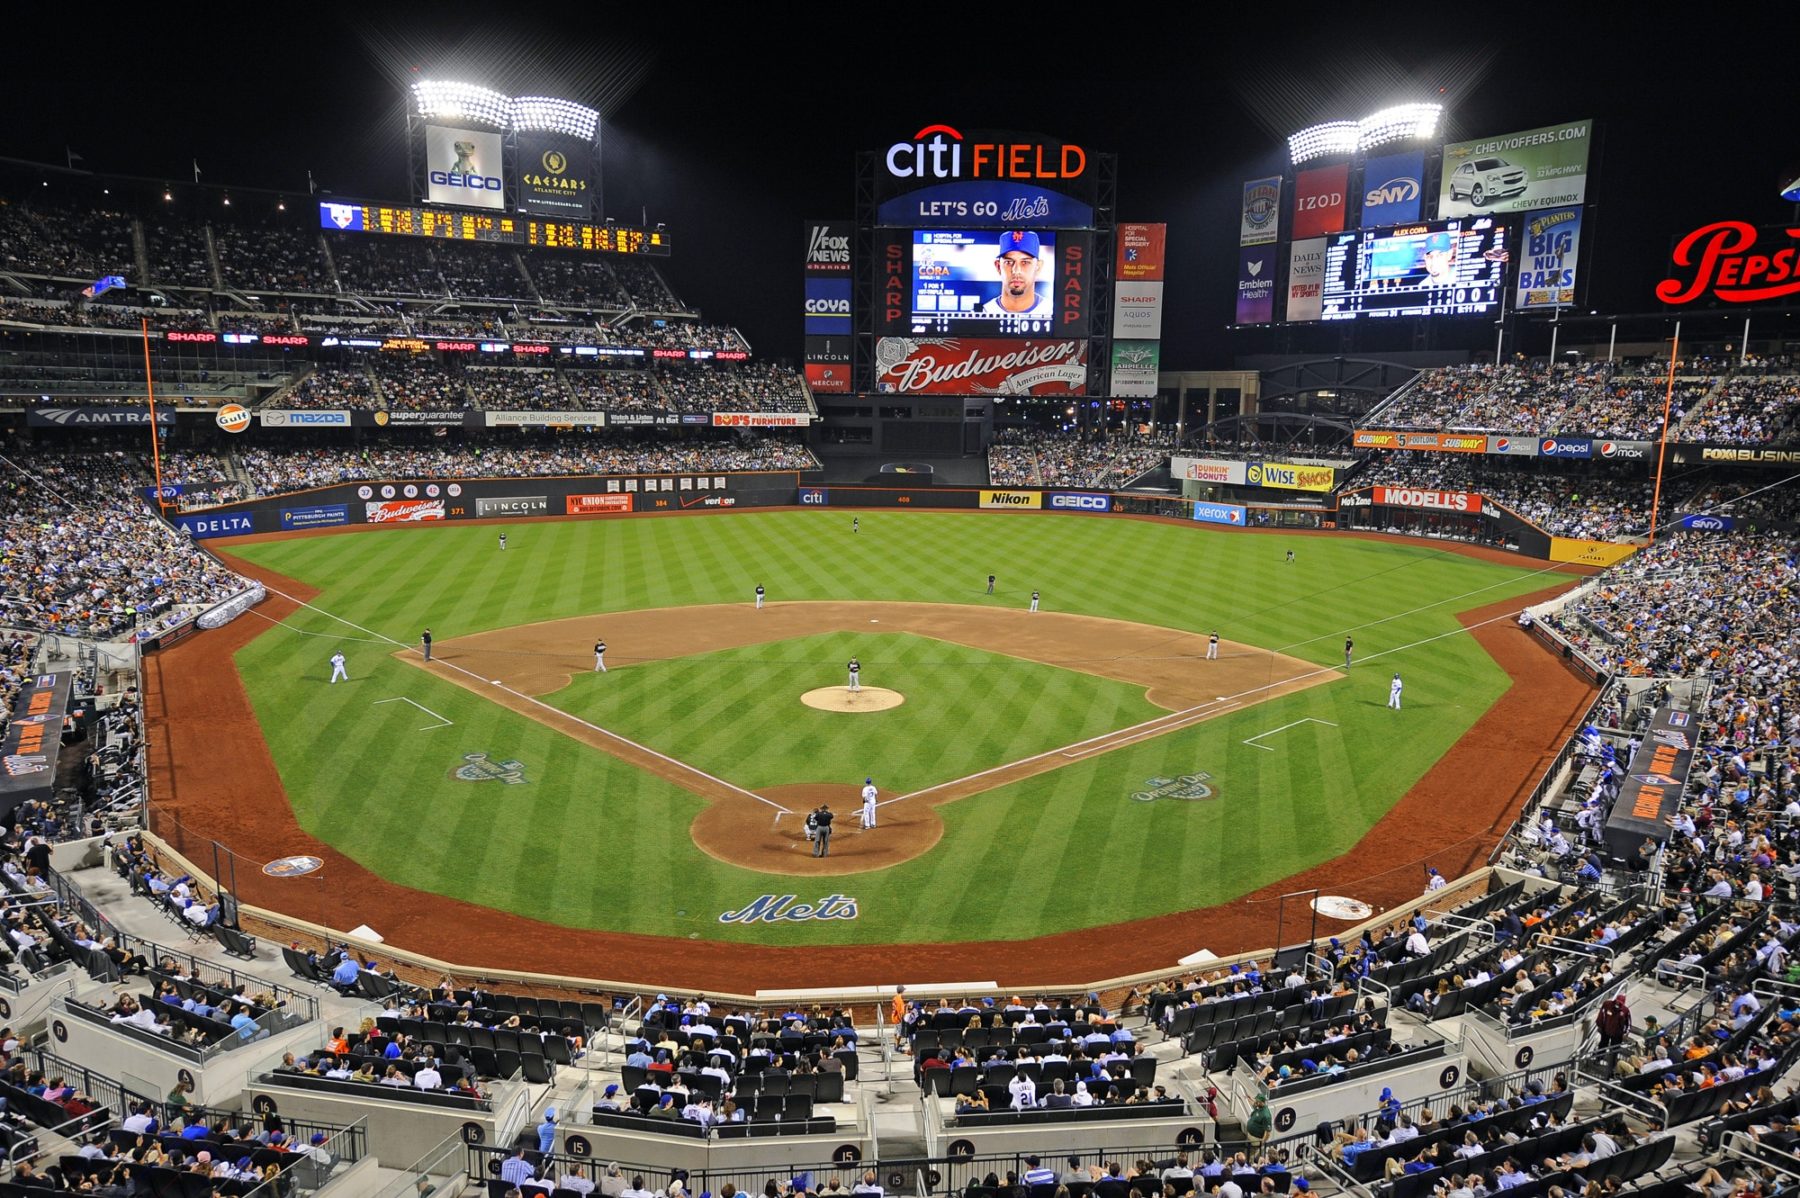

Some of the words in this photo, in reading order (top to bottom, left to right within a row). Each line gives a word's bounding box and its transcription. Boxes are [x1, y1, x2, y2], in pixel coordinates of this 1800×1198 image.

[1475, 126, 1586, 155] CHEVYOFFERS.COM
[886, 133, 960, 178] citi
[973, 144, 1086, 178] FIELD
[1546, 167, 1562, 177] MPG
[430, 171, 502, 191] GEICO
[523, 174, 587, 190] CAESARS
[534, 187, 562, 195] ATLANTIC
[1365, 186, 1411, 207] SNY
[1298, 192, 1342, 212] IZOD
[1512, 198, 1538, 209] CHEVY
[1540, 194, 1578, 205] EQUINOX
[920, 201, 968, 216] LET'S
[973, 201, 998, 216] GO
[1001, 196, 1049, 221] Mets
[1540, 212, 1576, 226] PLANTERS
[1409, 226, 1428, 235] CORA
[820, 236, 849, 250] FOX
[1528, 230, 1573, 257] BIG
[812, 250, 850, 262] NEWS
[1294, 252, 1322, 262] DAILY
[1534, 256, 1563, 270] NUT
[918, 266, 950, 276] CORA
[1293, 265, 1322, 275] NEWS
[886, 244, 904, 322] SHARP
[1064, 246, 1082, 324] SHARP
[1240, 280, 1272, 290] Emblem
[1242, 289, 1268, 299] Health
[1456, 289, 1466, 303] 0
[1471, 288, 1481, 301] 0
[1487, 289, 1495, 300] 1
[804, 299, 850, 313] GOYA
[1022, 321, 1029, 332] 0
[1032, 321, 1040, 332] 0
[168, 332, 216, 342] SHARP
[262, 336, 308, 344] SHARP
[436, 342, 476, 350] SHARP
[888, 338, 1075, 393] Budweiser
[1015, 372, 1054, 389] American
[1056, 368, 1082, 381] Lager
[75, 413, 168, 422] AMTRAK
[220, 412, 248, 425] Gulf
[290, 413, 345, 423] mazda
[390, 412, 464, 420] superguarantee
[496, 414, 527, 422] Alliance
[530, 414, 562, 422] Building
[564, 414, 597, 422] Services
[714, 414, 750, 426] BOB'S
[1357, 435, 1392, 444] SUBWAY
[1396, 435, 1406, 447] $5
[1410, 436, 1438, 445] FOOTLONG
[1442, 438, 1483, 449] SUBWAY
[1511, 442, 1531, 451] pepsi
[1558, 443, 1589, 454] pepsi
[1617, 448, 1643, 458] max
[1702, 448, 1735, 460] FOX
[1738, 450, 1800, 462] BUSINE
[1198, 464, 1230, 473] DUNKIN'
[1198, 472, 1228, 481] DONUTS
[1265, 468, 1295, 484] WISE
[1297, 470, 1332, 488] SNACKS
[582, 496, 605, 505] UNION
[705, 496, 735, 505] verizon
[803, 491, 822, 504] citi
[991, 493, 1030, 506] Nikon
[1052, 495, 1107, 509] GEICO
[1341, 497, 1355, 506] Mo's
[1356, 496, 1371, 506] Zone
[1384, 489, 1468, 511] MODELL'S
[372, 500, 440, 522] Budweiser
[485, 502, 547, 511] LINCOLN
[1198, 507, 1228, 520] xerox
[197, 518, 251, 532] DELTA
[1692, 518, 1719, 530] SNY
[719, 894, 858, 923] Mets
[56, 1026, 63, 1036] 17
[1522, 1052, 1529, 1062] 12
[1446, 1072, 1454, 1082] 13
[1021, 1093, 1032, 1105] 21
[260, 1102, 270, 1112] 16
[1281, 1114, 1290, 1125] 13
[468, 1129, 478, 1140] 16
[1186, 1134, 1195, 1144] 14
[574, 1142, 584, 1153] 15
[957, 1146, 967, 1155] 14
[842, 1152, 853, 1162] 15
[492, 1163, 500, 1171] 15
[892, 1176, 900, 1184] 15
